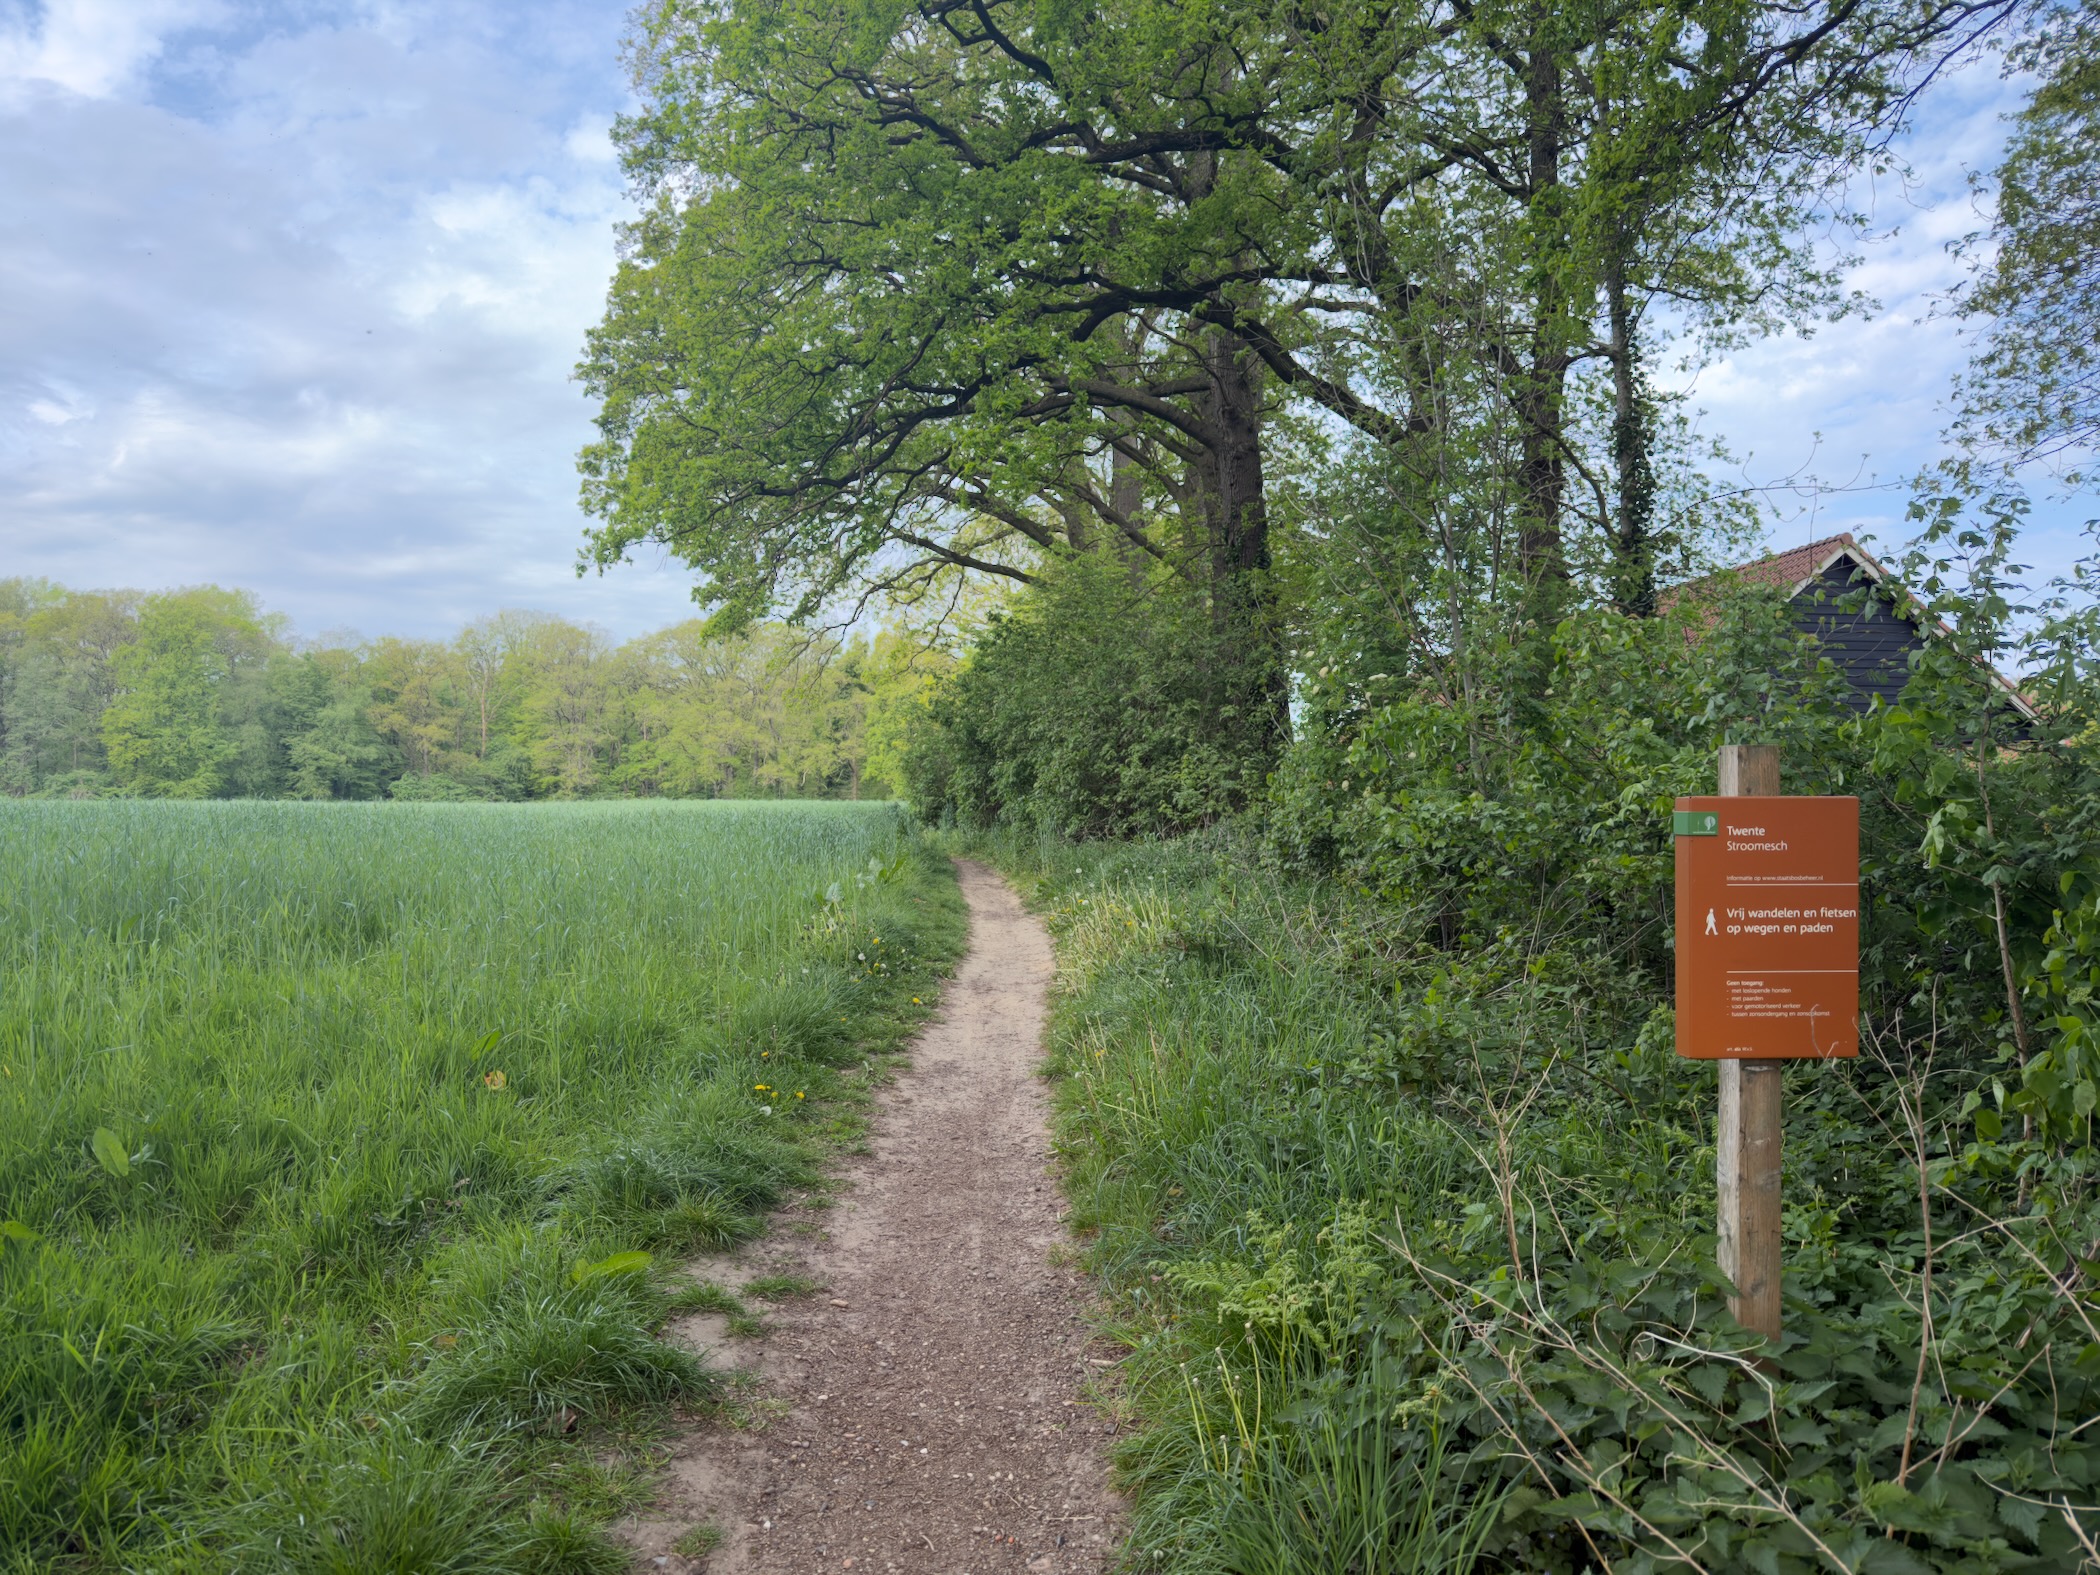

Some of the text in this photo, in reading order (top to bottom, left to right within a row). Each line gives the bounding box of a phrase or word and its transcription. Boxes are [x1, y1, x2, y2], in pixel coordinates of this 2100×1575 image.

[1726, 825, 1765, 836] Twente
[1726, 840, 1788, 851] Stroomesch
[1727, 907, 1856, 920] Vrij wandelen en fietsen
[1726, 922, 1833, 935] op wegen en paden
